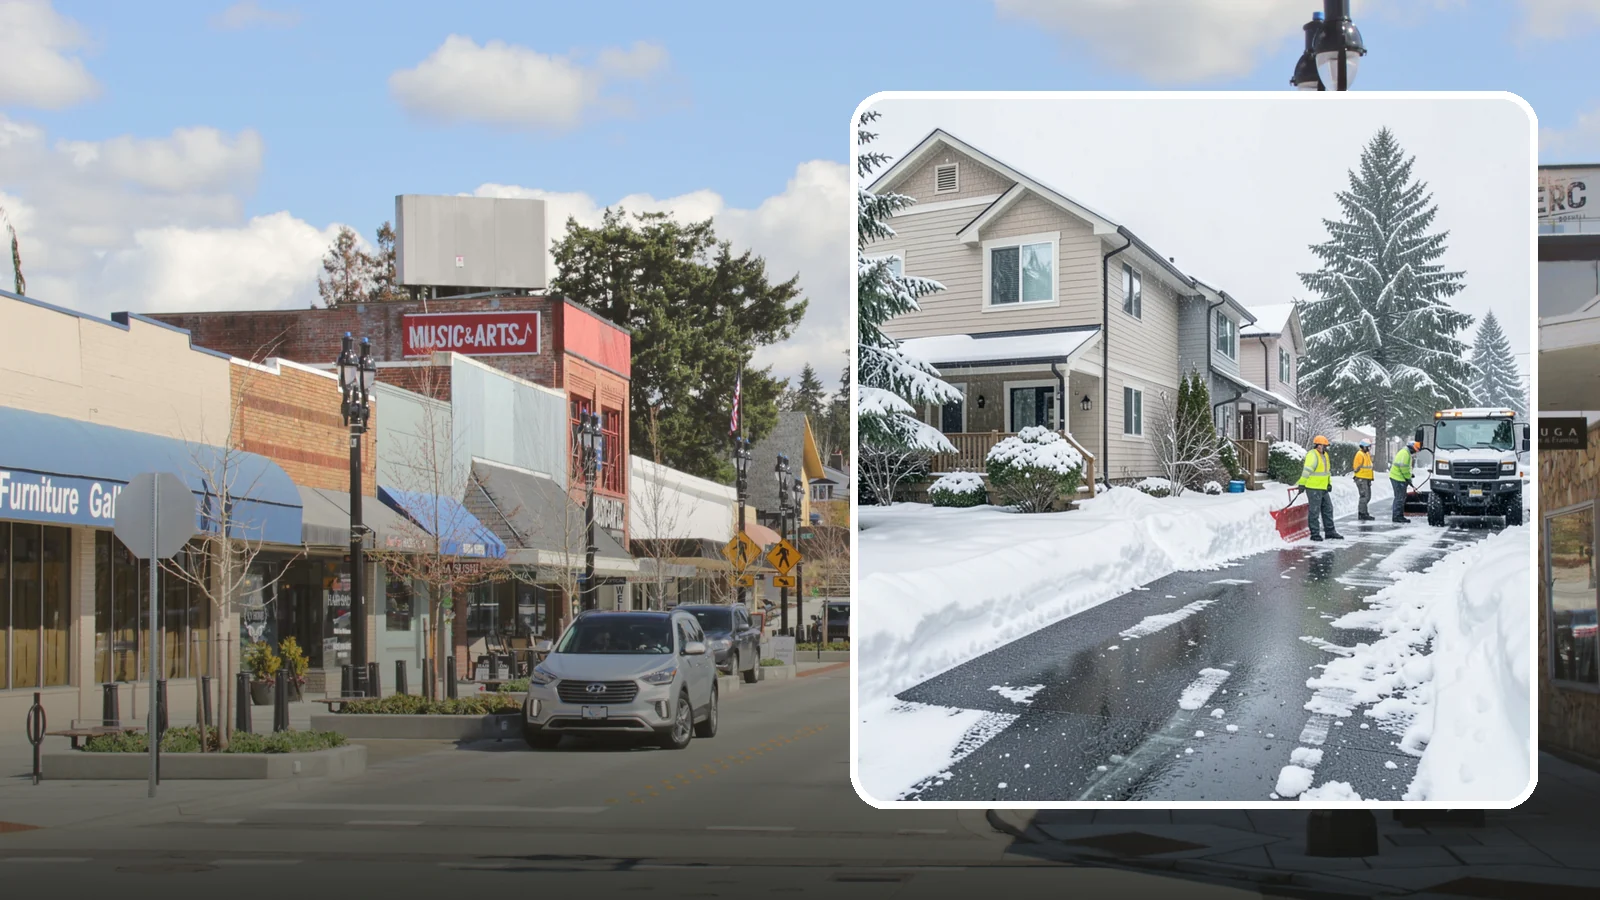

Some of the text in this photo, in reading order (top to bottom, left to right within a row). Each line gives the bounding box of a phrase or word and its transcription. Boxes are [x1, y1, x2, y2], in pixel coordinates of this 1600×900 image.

[408, 322, 520, 348] MUSIC&ARTS
[0, 471, 122, 519] Furniture Gal
